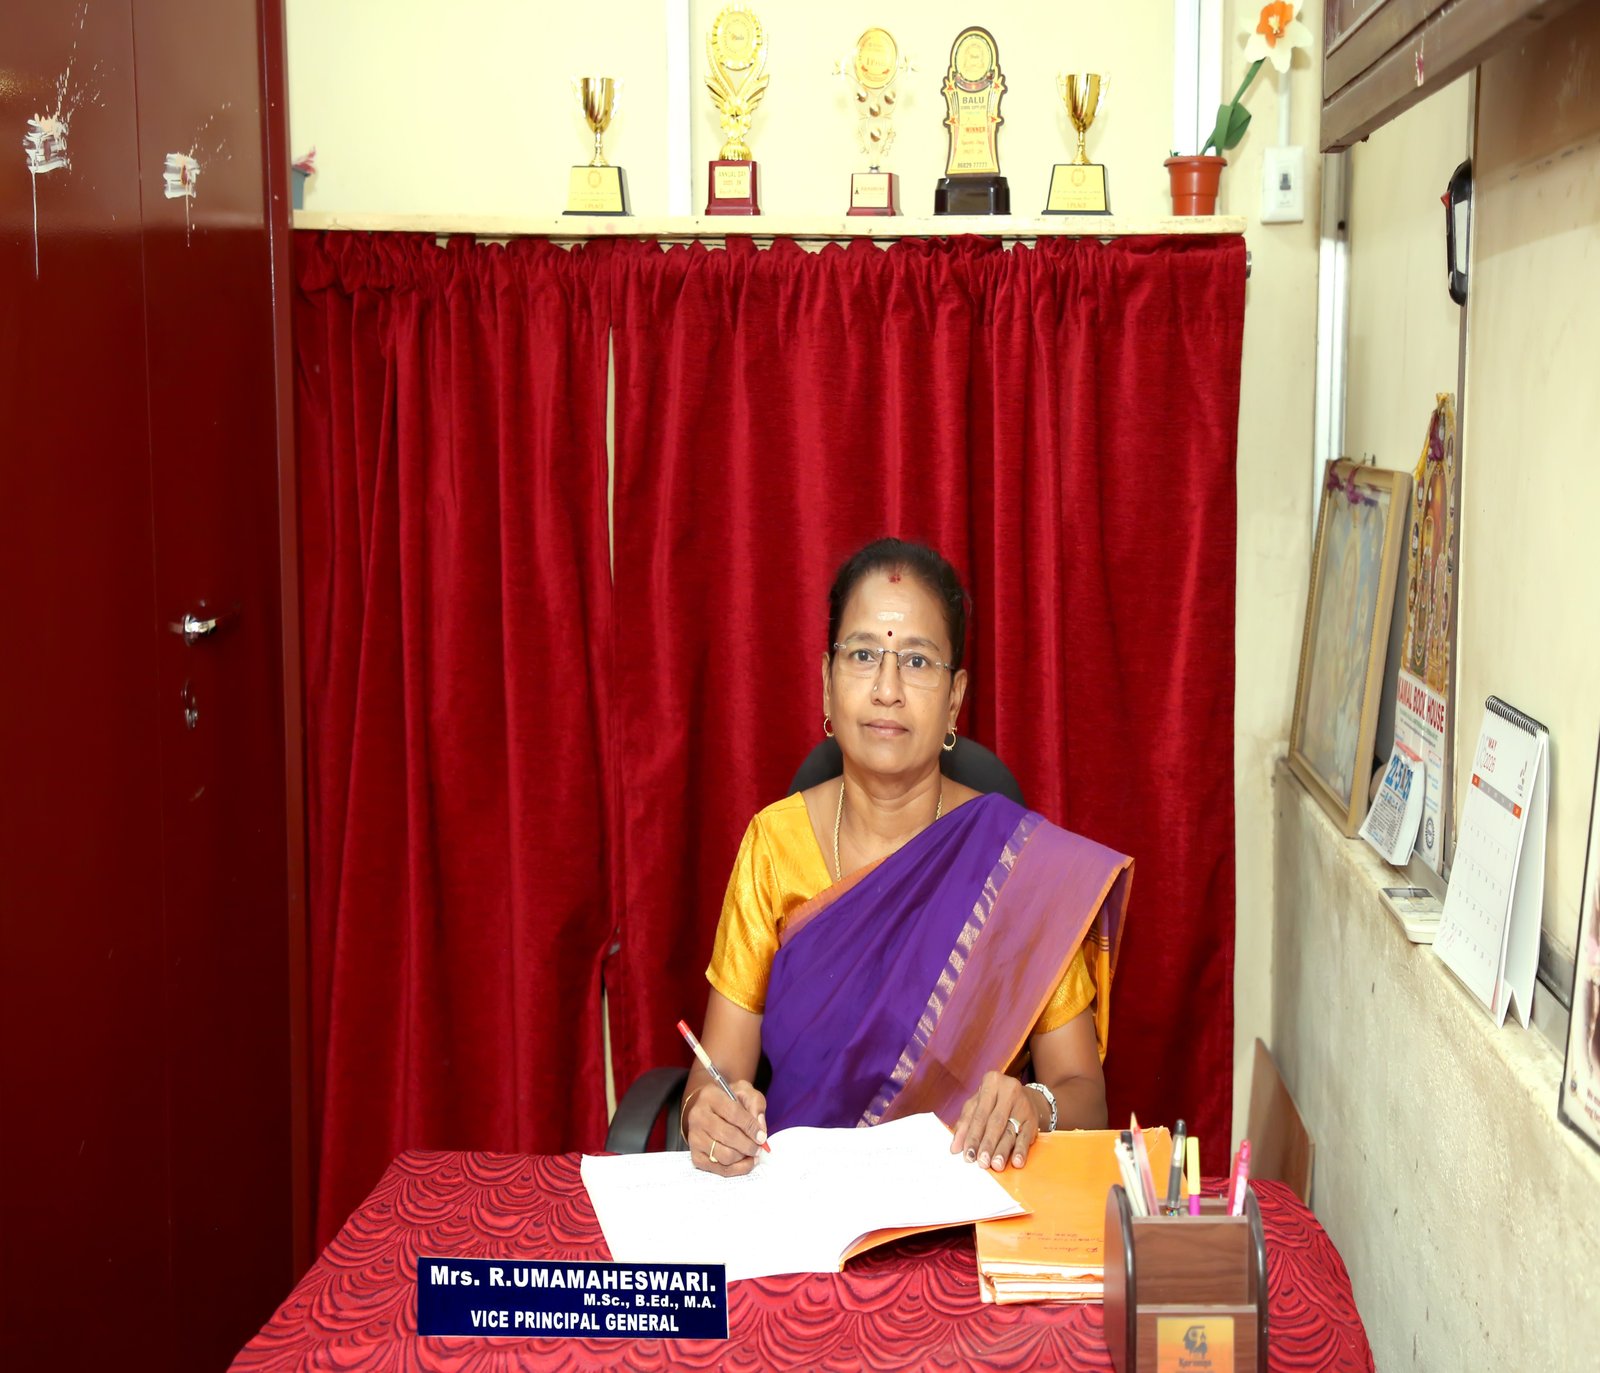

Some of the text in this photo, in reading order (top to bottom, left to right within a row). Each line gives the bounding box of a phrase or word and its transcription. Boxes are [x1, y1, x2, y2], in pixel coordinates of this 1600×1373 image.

[962, 96, 985, 104] BALU
[1427, 695, 1445, 733] HOUSE
[1487, 738, 1497, 750] MAY
[430, 1265, 716, 1292] Mrs. R.UMAMAHESWARI.
[583, 1293, 716, 1310] M.Sc., B.Ed., M.A.
[470, 1310, 680, 1332] VICE PRINCIPAL GENERAL
